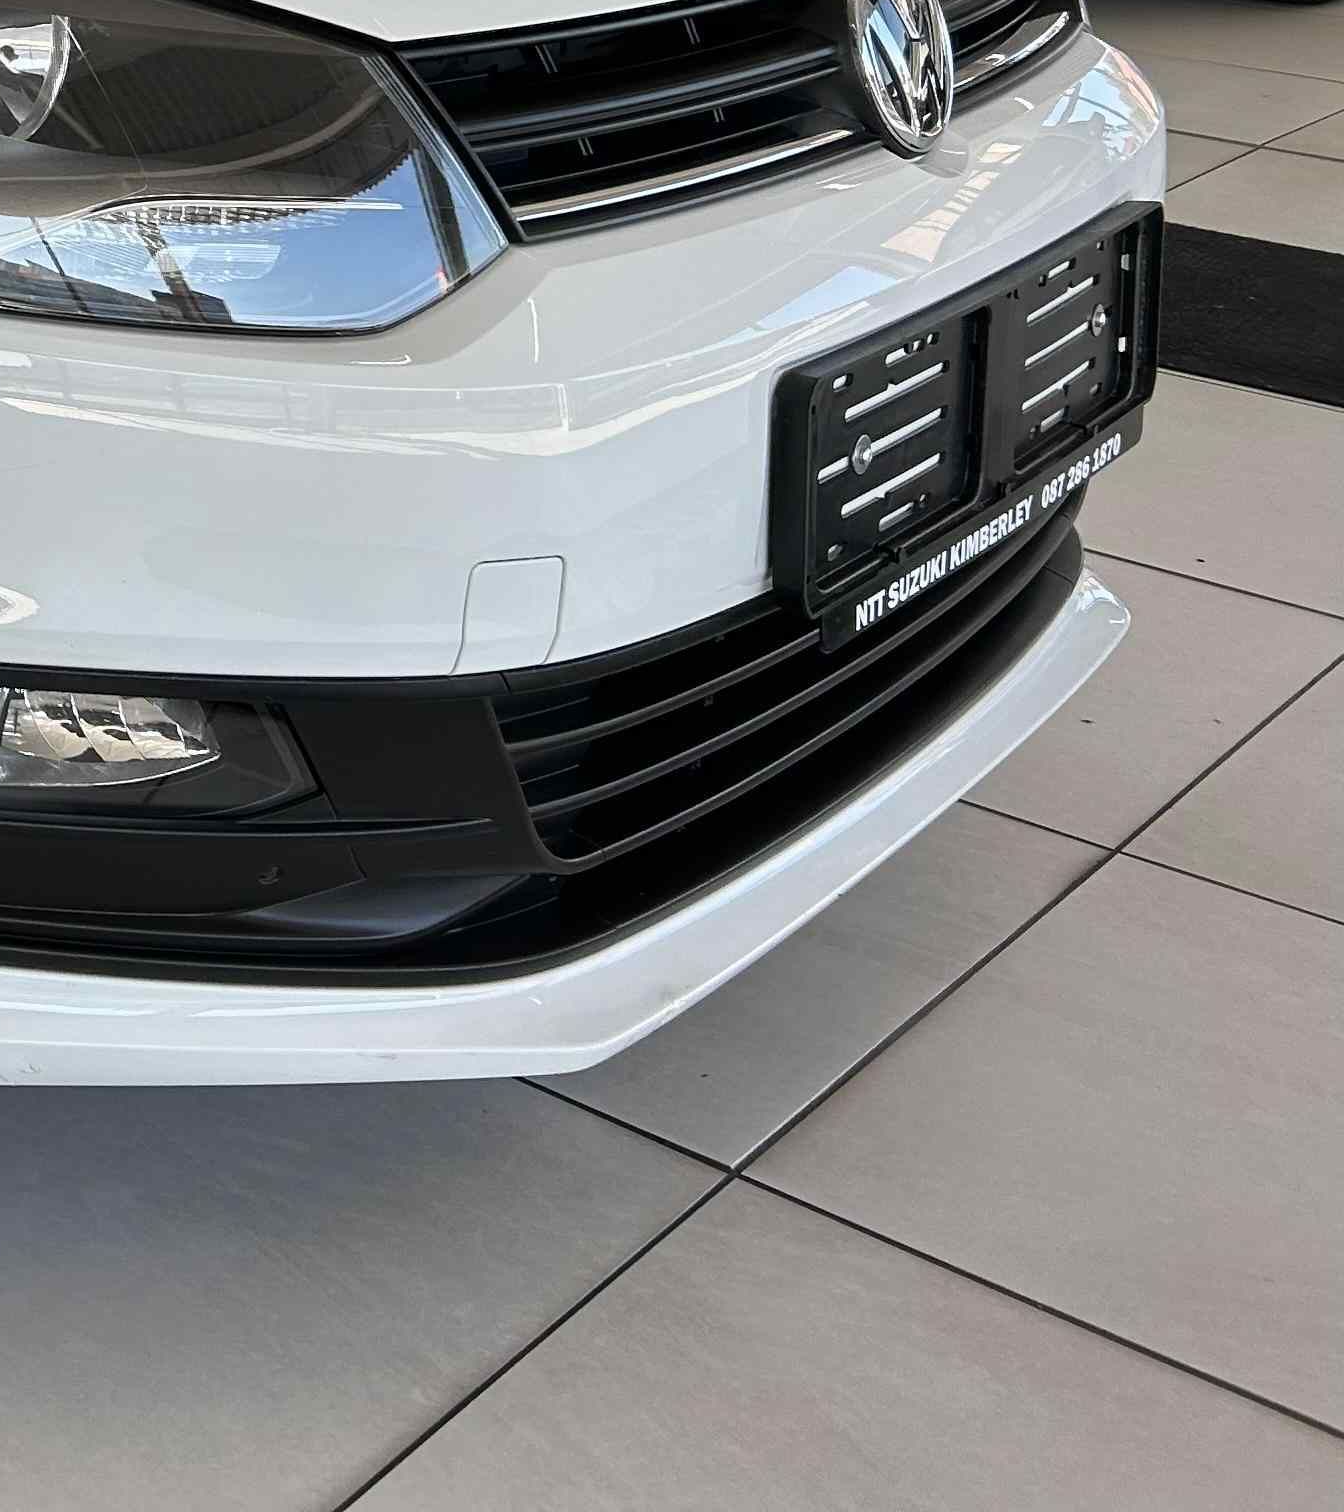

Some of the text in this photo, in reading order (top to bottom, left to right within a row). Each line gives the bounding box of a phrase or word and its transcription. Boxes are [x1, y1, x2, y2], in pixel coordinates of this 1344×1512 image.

[855, 589, 887, 631] NTT
[887, 551, 947, 609] SUZUKI
[950, 495, 1034, 570] KIMBERLEY
[1040, 473, 1063, 508] 087
[1091, 433, 1121, 472] 1870
